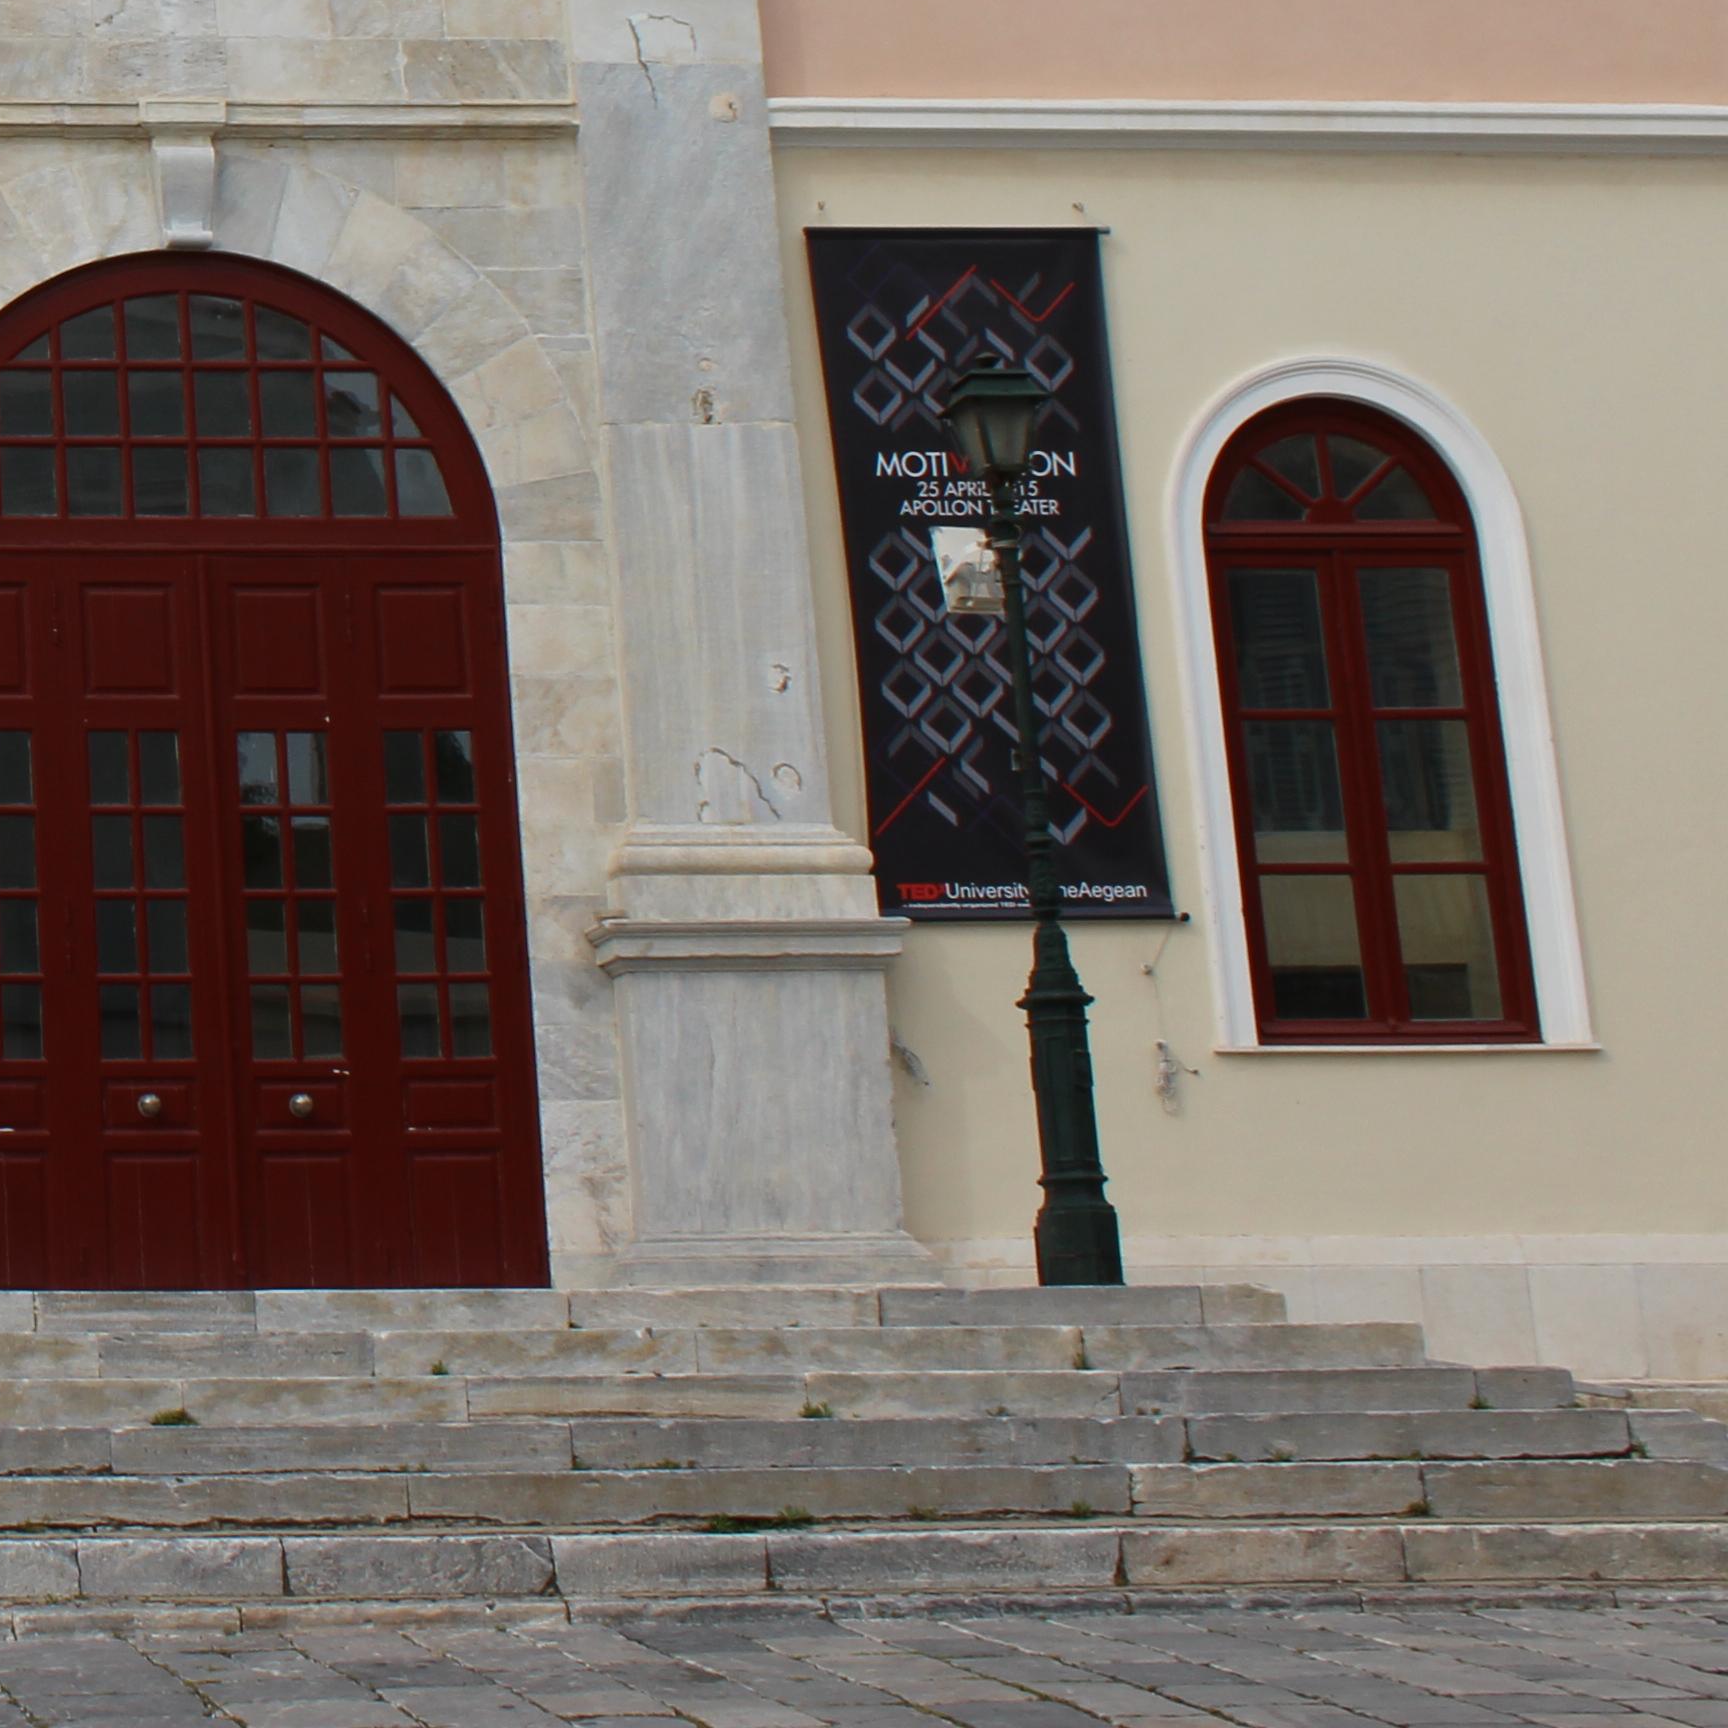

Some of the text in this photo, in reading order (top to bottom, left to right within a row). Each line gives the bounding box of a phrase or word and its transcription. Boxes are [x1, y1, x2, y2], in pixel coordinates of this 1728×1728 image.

[917, 480, 940, 498] 25
[944, 480, 991, 497] APRIL
[899, 499, 983, 516] APOLLON
